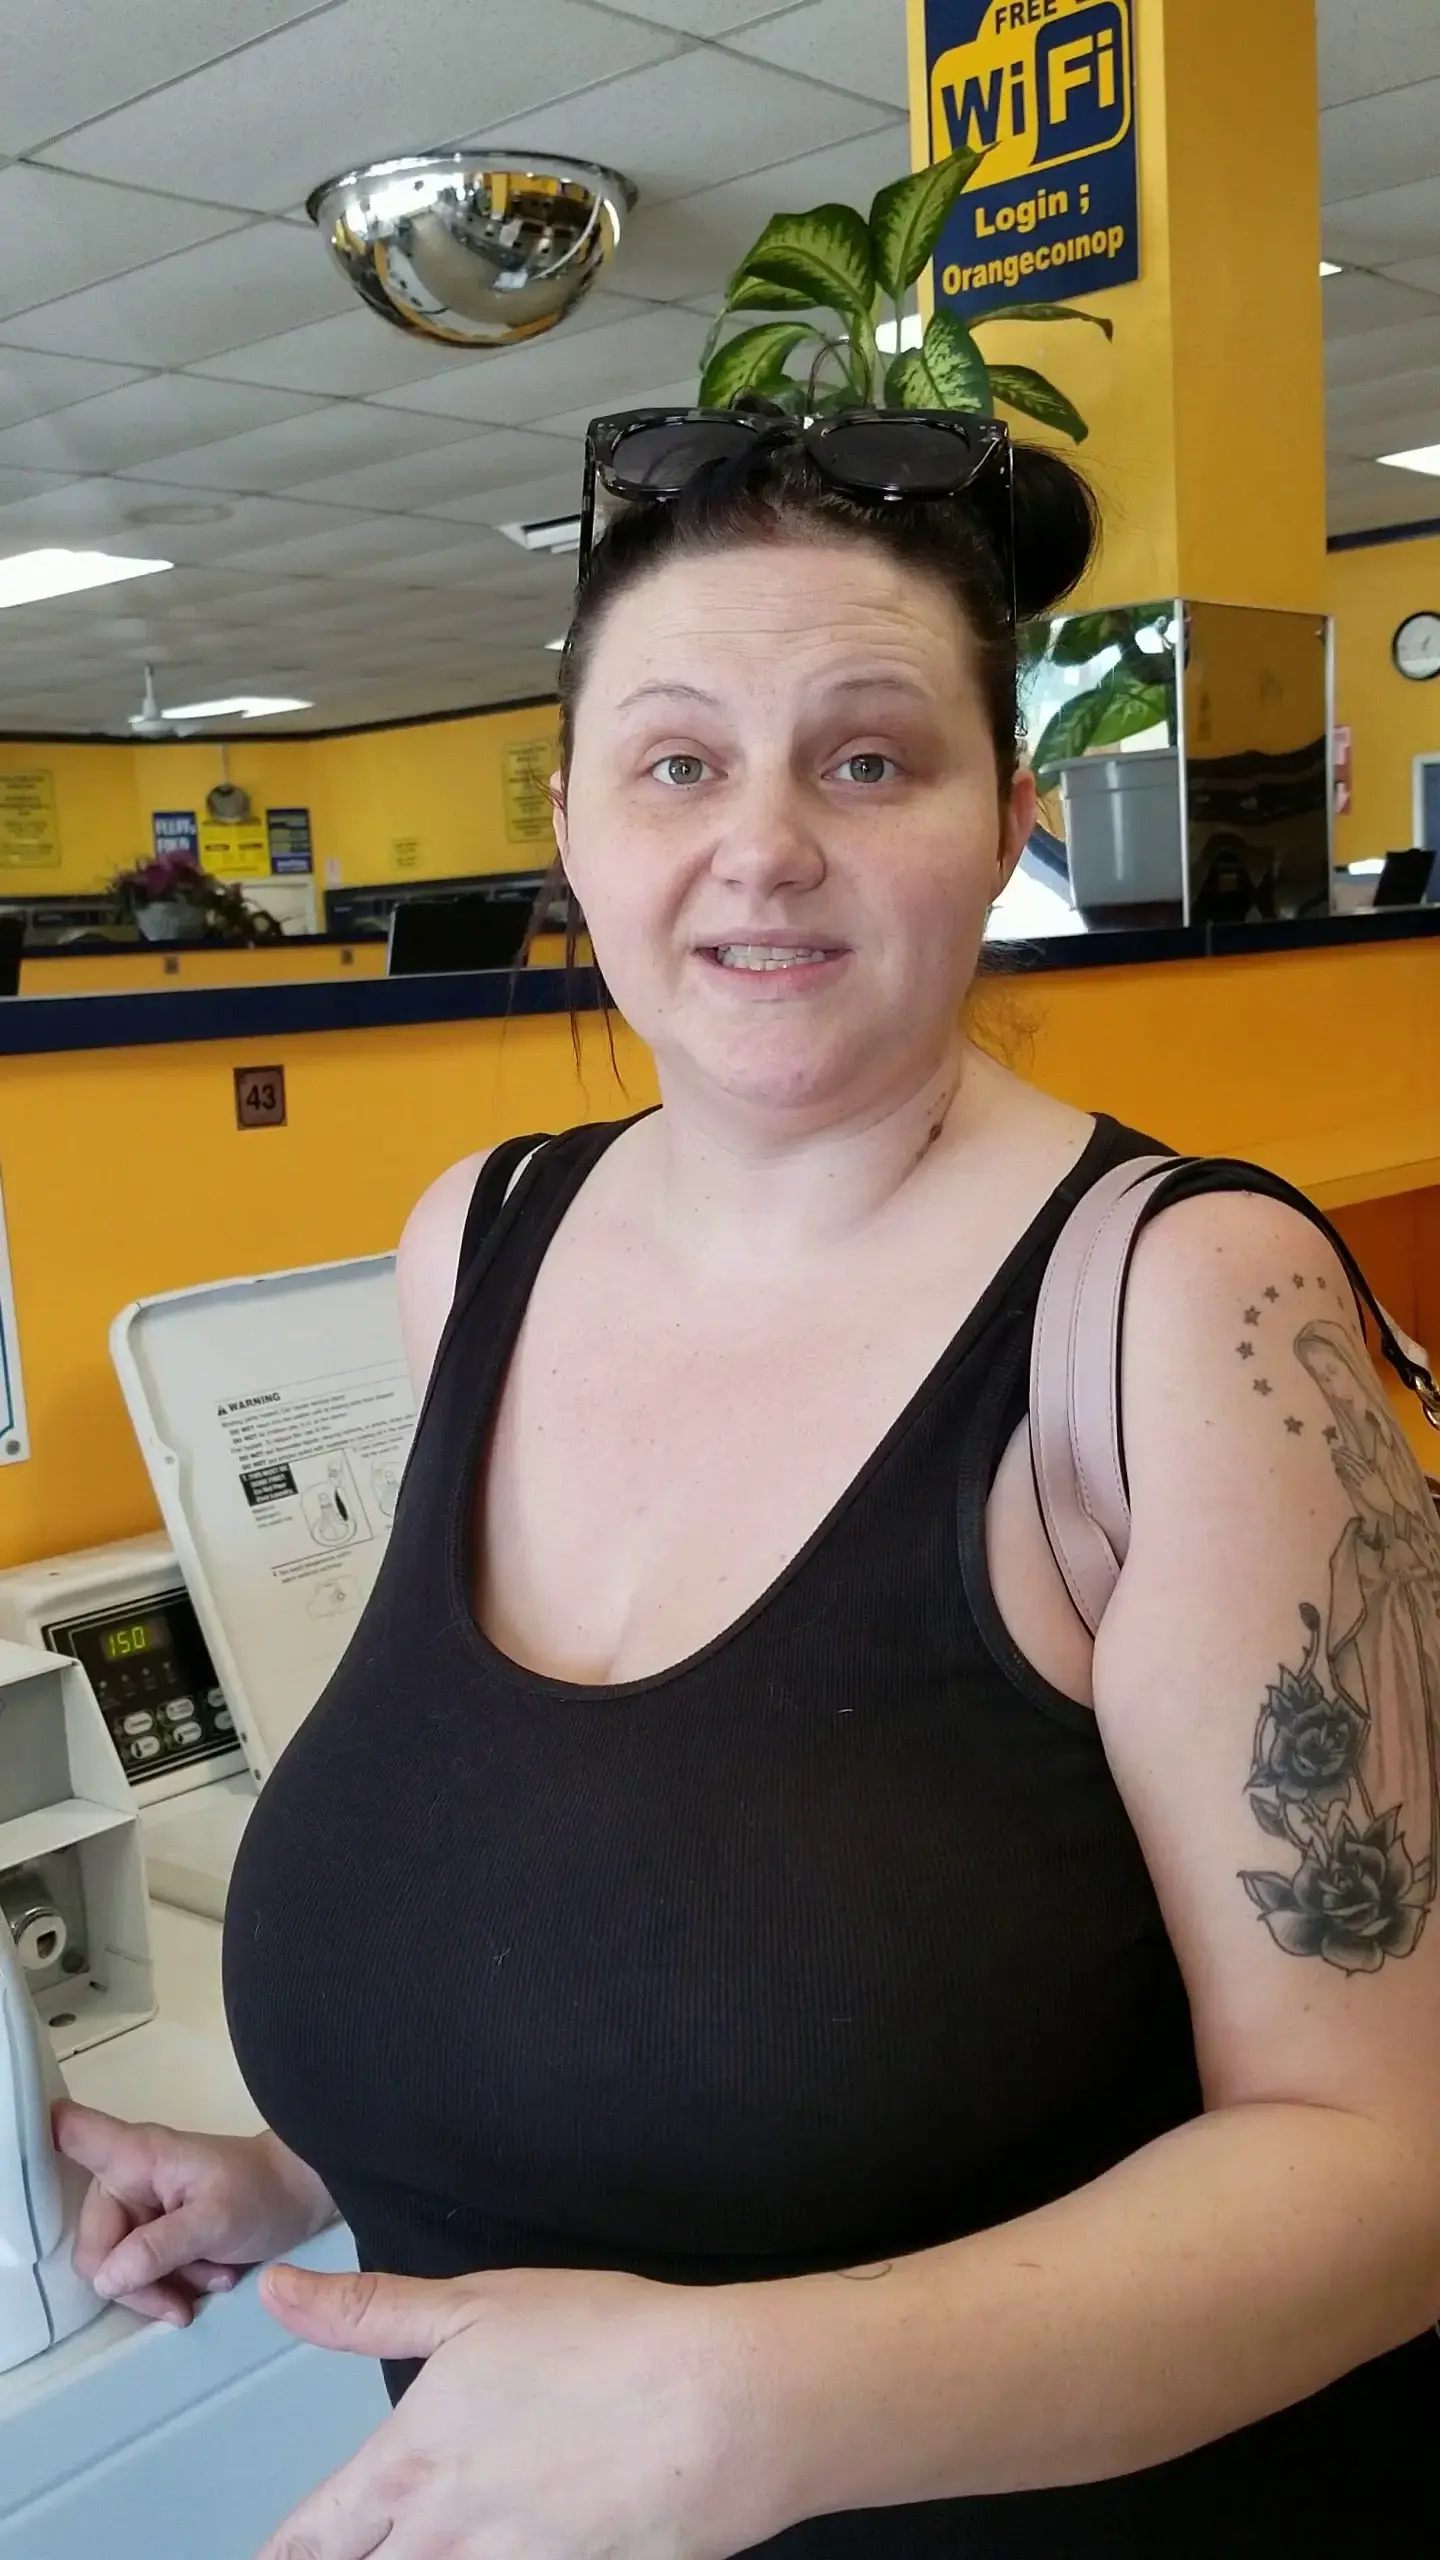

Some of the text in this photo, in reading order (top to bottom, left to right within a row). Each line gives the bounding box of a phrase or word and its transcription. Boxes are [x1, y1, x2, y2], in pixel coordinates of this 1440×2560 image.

[995, 0, 1058, 34] FREE
[975, 188, 1068, 238] Login
[246, 1084, 276, 1111] 43
[228, 1392, 281, 1412] WARNING
[108, 1626, 145, 1656] 150
